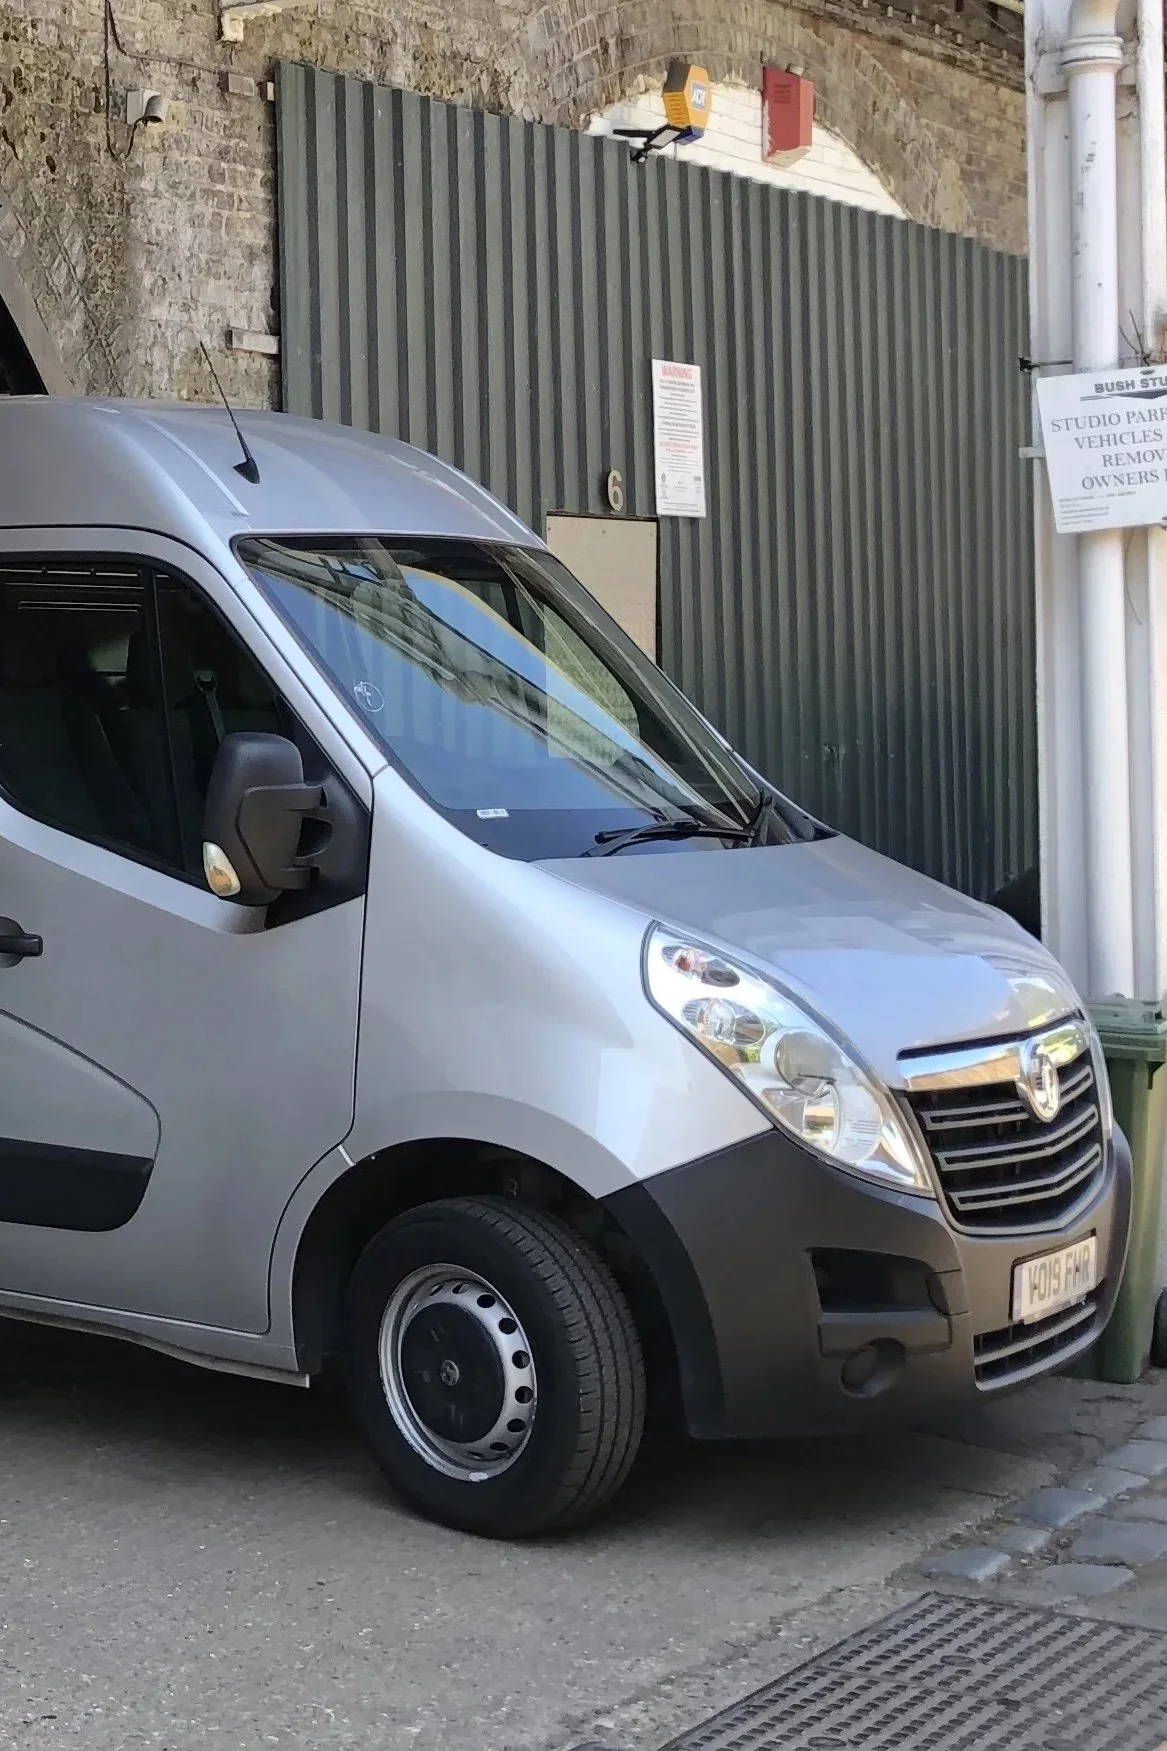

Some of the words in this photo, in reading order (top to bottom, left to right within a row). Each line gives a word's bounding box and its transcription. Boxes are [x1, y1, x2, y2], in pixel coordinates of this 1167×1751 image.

[1094, 379, 1135, 393] BUSH
[1140, 375, 1167, 389] STU
[1051, 412, 1121, 433] STUDIO
[1074, 428, 1163, 450] VEHICLES
[1102, 448, 1166, 468] REMOV
[1082, 469, 1160, 490] OWNERS
[607, 469, 624, 512] 6
